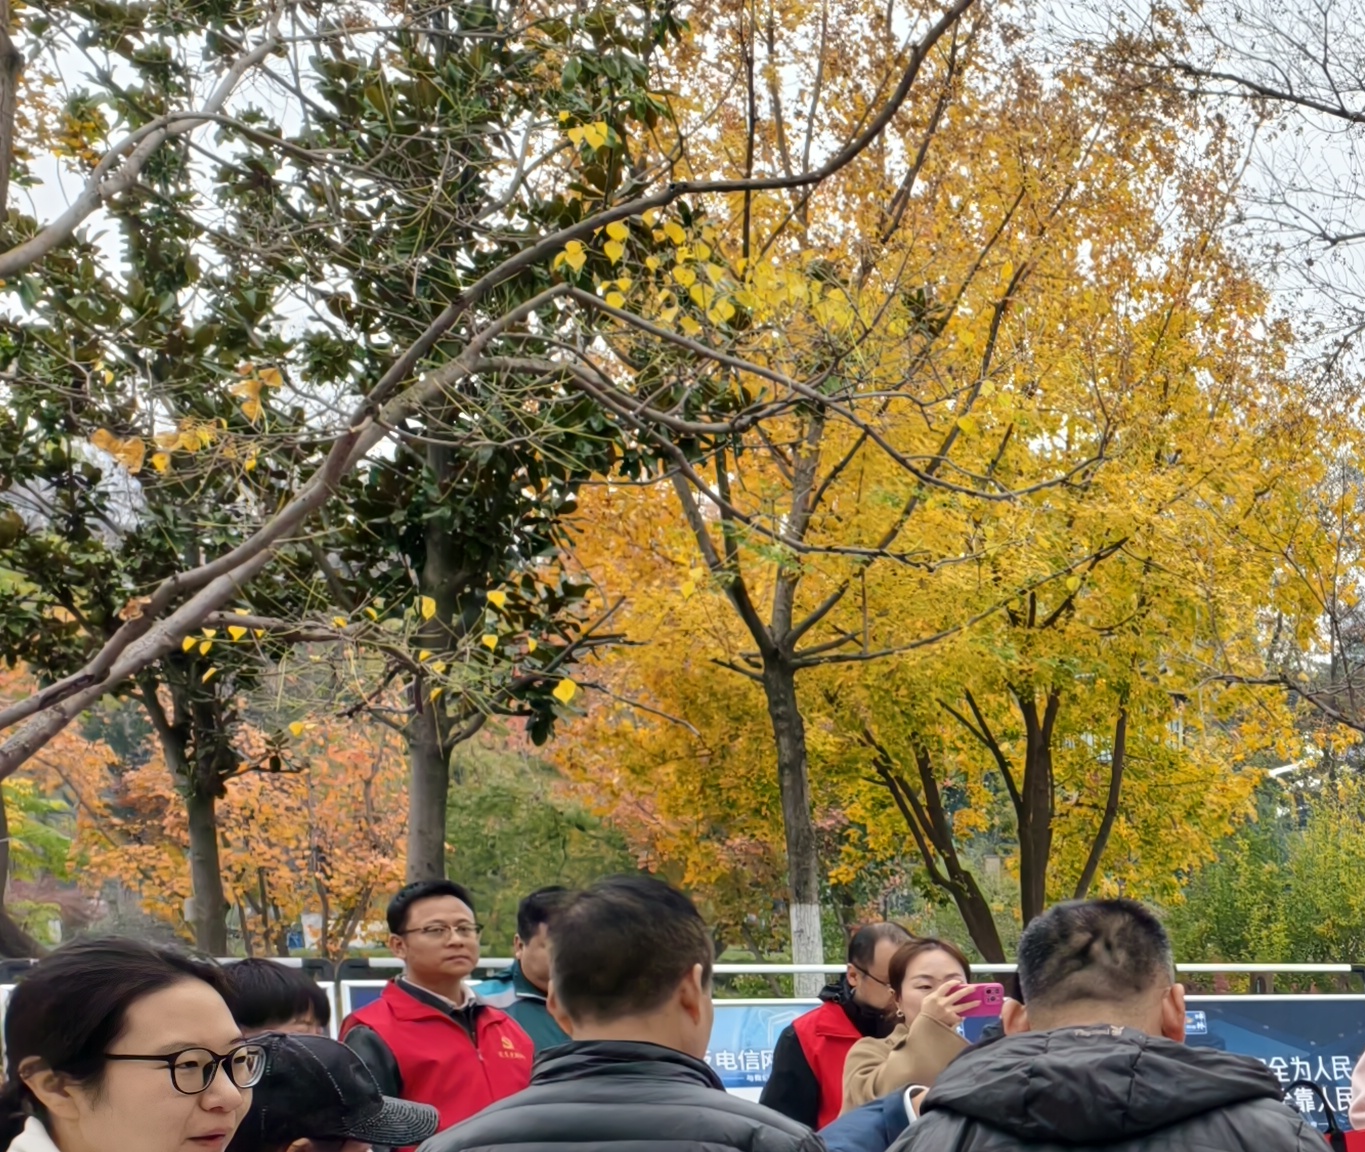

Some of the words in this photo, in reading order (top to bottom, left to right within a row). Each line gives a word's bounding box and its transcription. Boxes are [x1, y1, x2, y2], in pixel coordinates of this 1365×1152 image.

[1260, 1056, 1352, 1082] 全为人民
[1282, 1086, 1352, 1113] 靠人民
